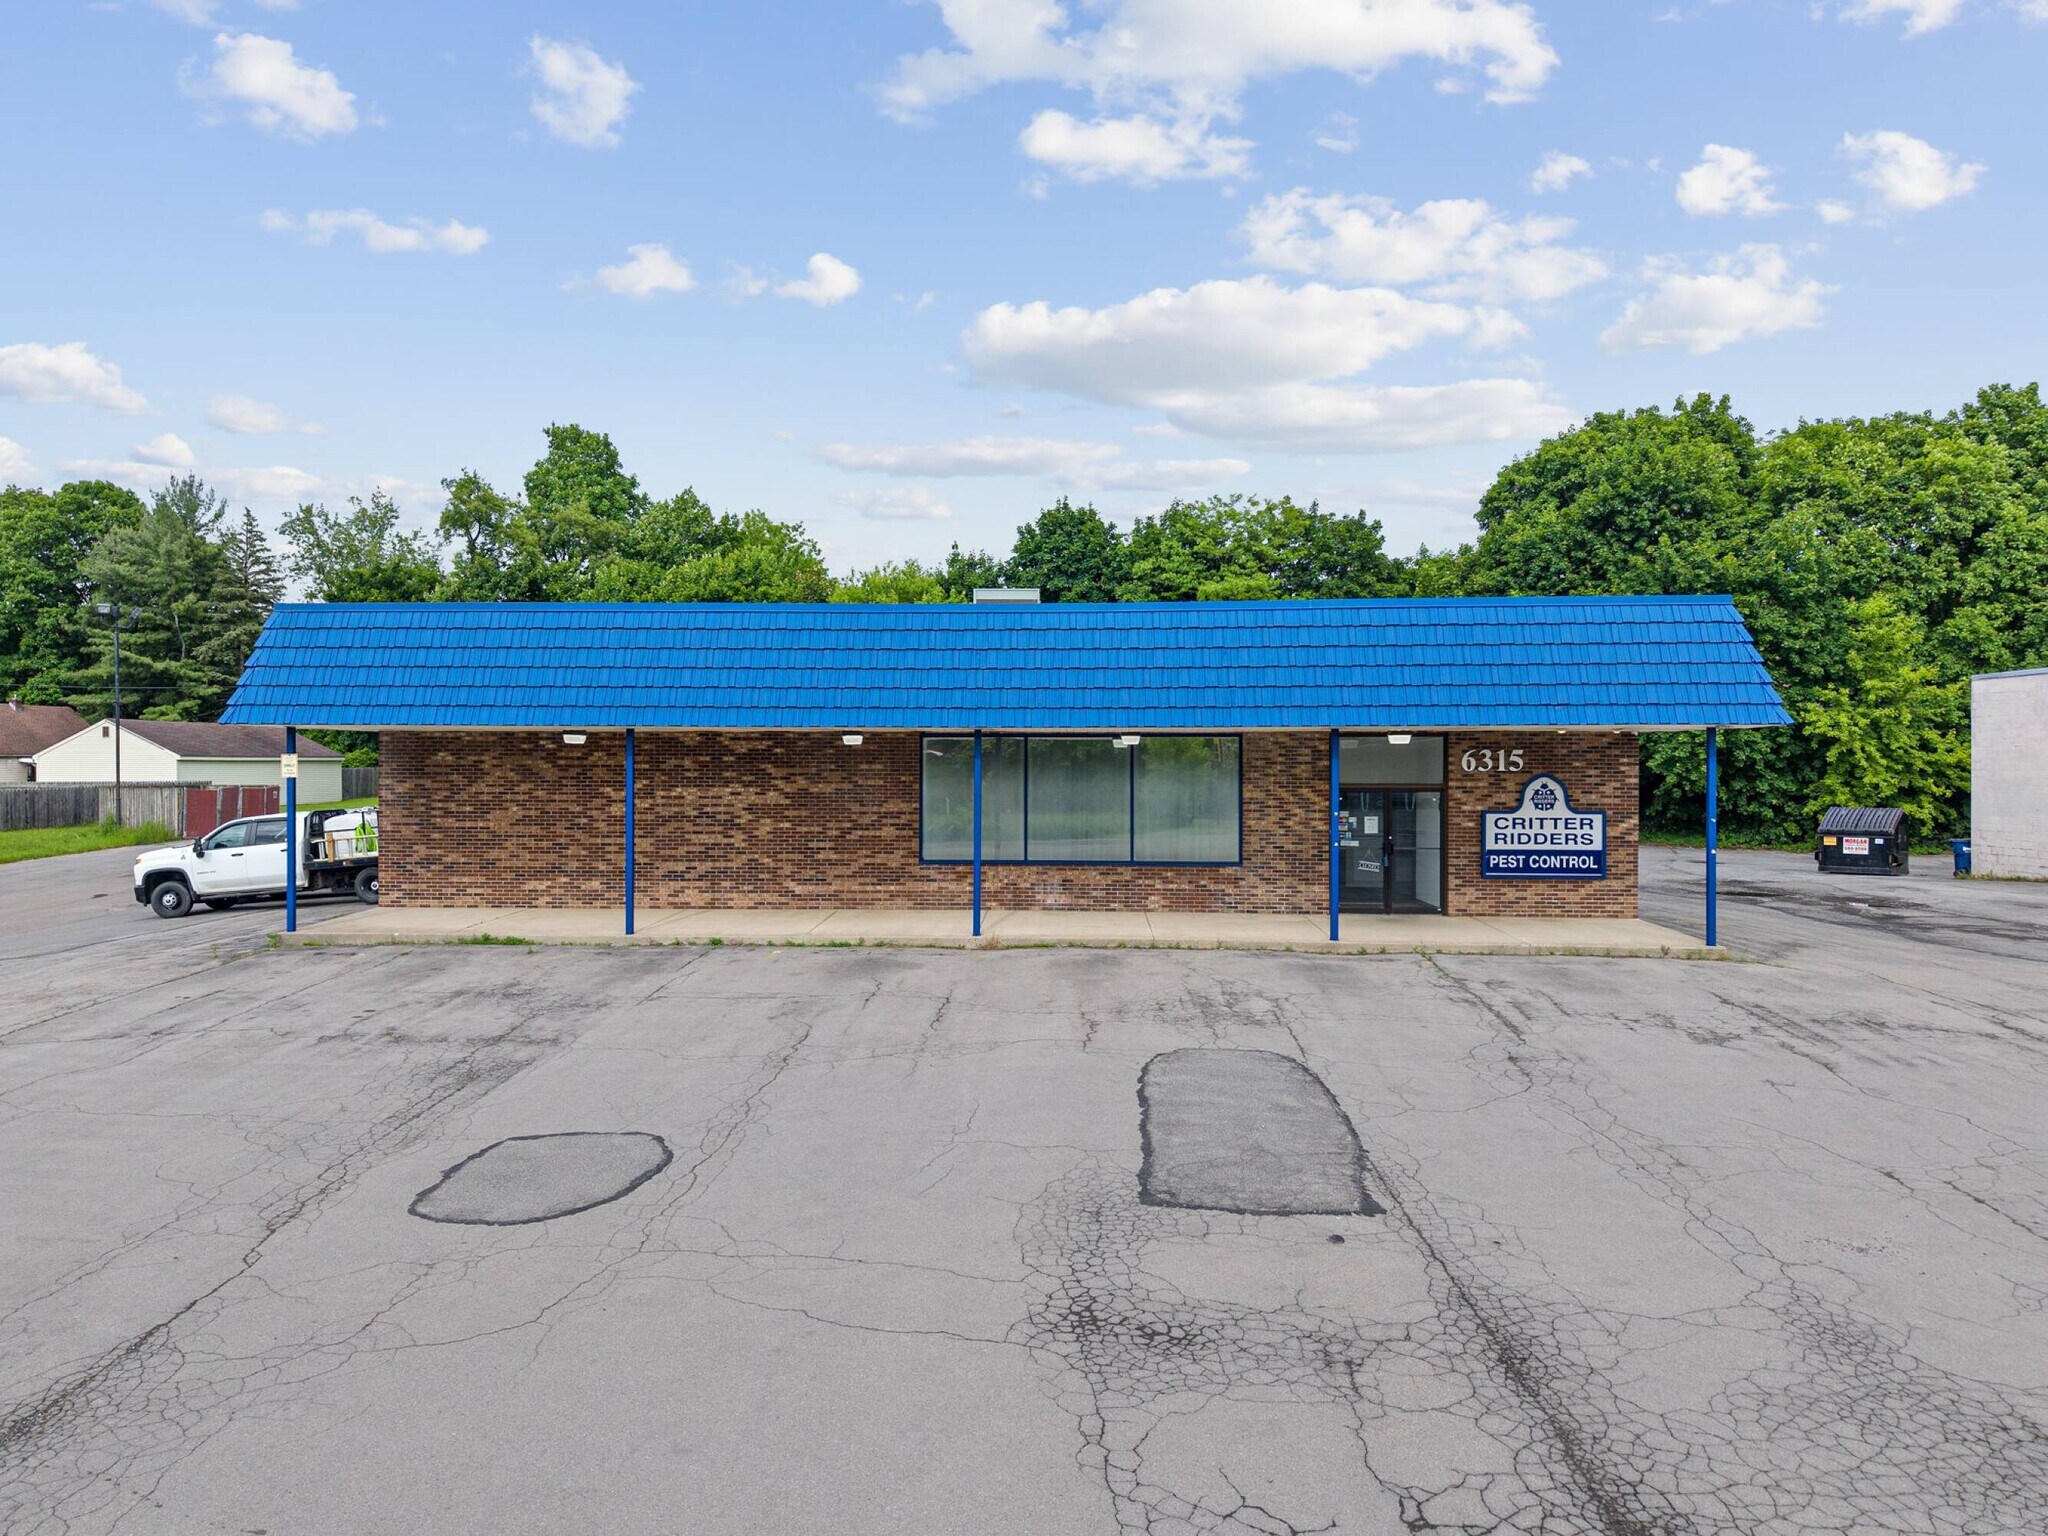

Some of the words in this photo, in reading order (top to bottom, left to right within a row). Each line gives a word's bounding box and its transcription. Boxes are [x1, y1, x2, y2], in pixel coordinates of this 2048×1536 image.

[1461, 749, 1524, 772] 6315
[1494, 817, 1594, 830] CRITTER
[1494, 833, 1594, 845] RIDDERS
[1489, 855, 1526, 868] PEST
[1529, 855, 1598, 869] CONTROL
